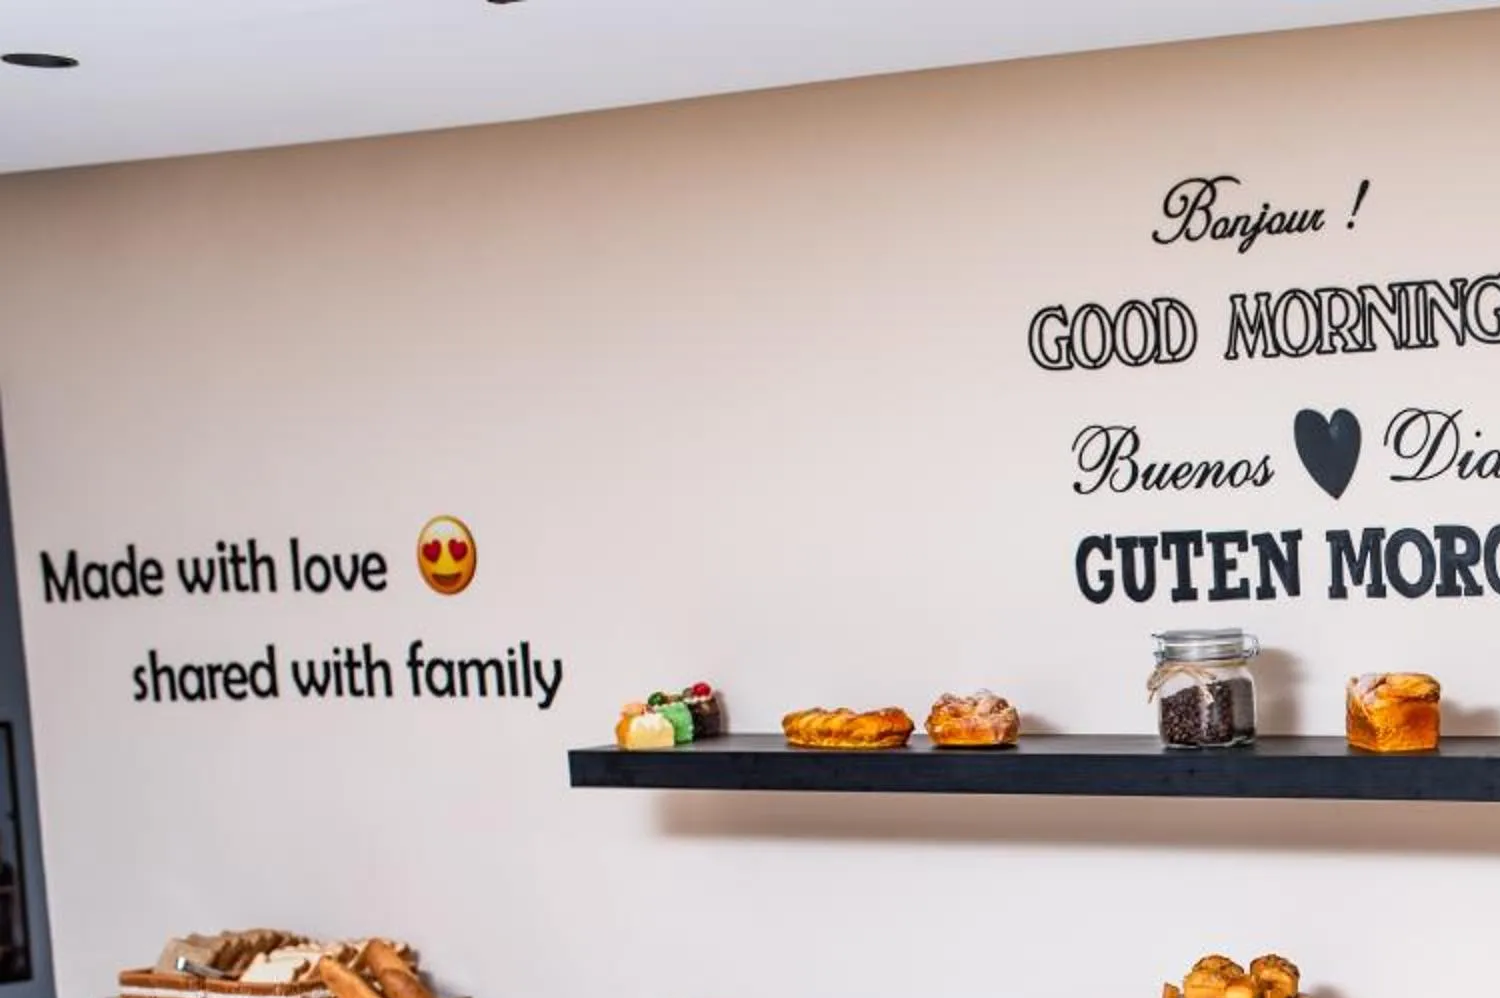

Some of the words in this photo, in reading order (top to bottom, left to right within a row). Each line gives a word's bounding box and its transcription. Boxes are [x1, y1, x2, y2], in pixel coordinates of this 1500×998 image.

[1151, 175, 1326, 254] Bonjour
[1028, 297, 1198, 371] GOOD
[1071, 424, 1275, 496] Buenos
[38, 543, 165, 604] Made
[177, 538, 278, 594] with
[289, 536, 389, 594] love
[1074, 529, 1303, 605] GUTEN
[132, 643, 279, 703] shared
[290, 643, 393, 698] with
[405, 639, 563, 710] family
